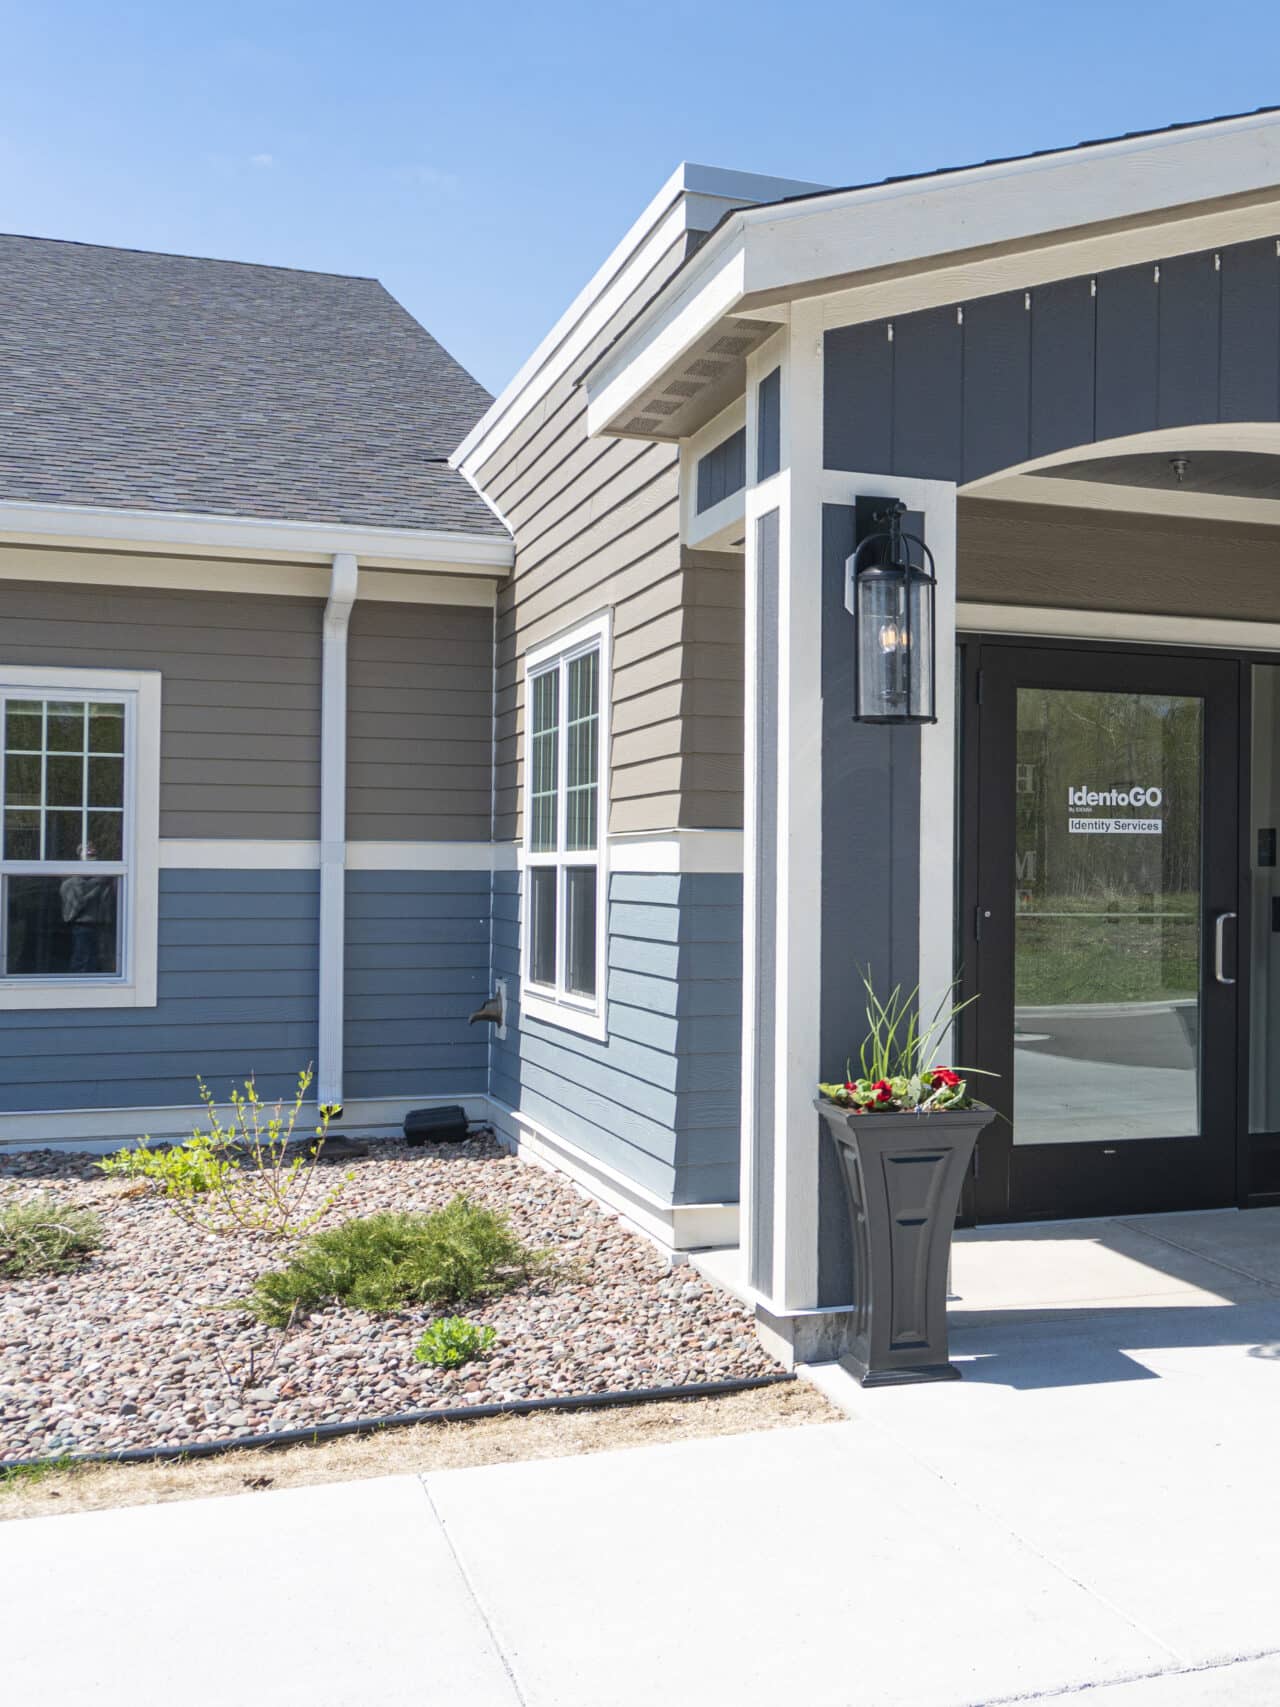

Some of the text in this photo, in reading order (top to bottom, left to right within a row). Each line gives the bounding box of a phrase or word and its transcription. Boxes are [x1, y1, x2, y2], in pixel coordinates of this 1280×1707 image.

[1068, 785, 1162, 807] IdentoGO
[1071, 820, 1159, 832] Identity Services
